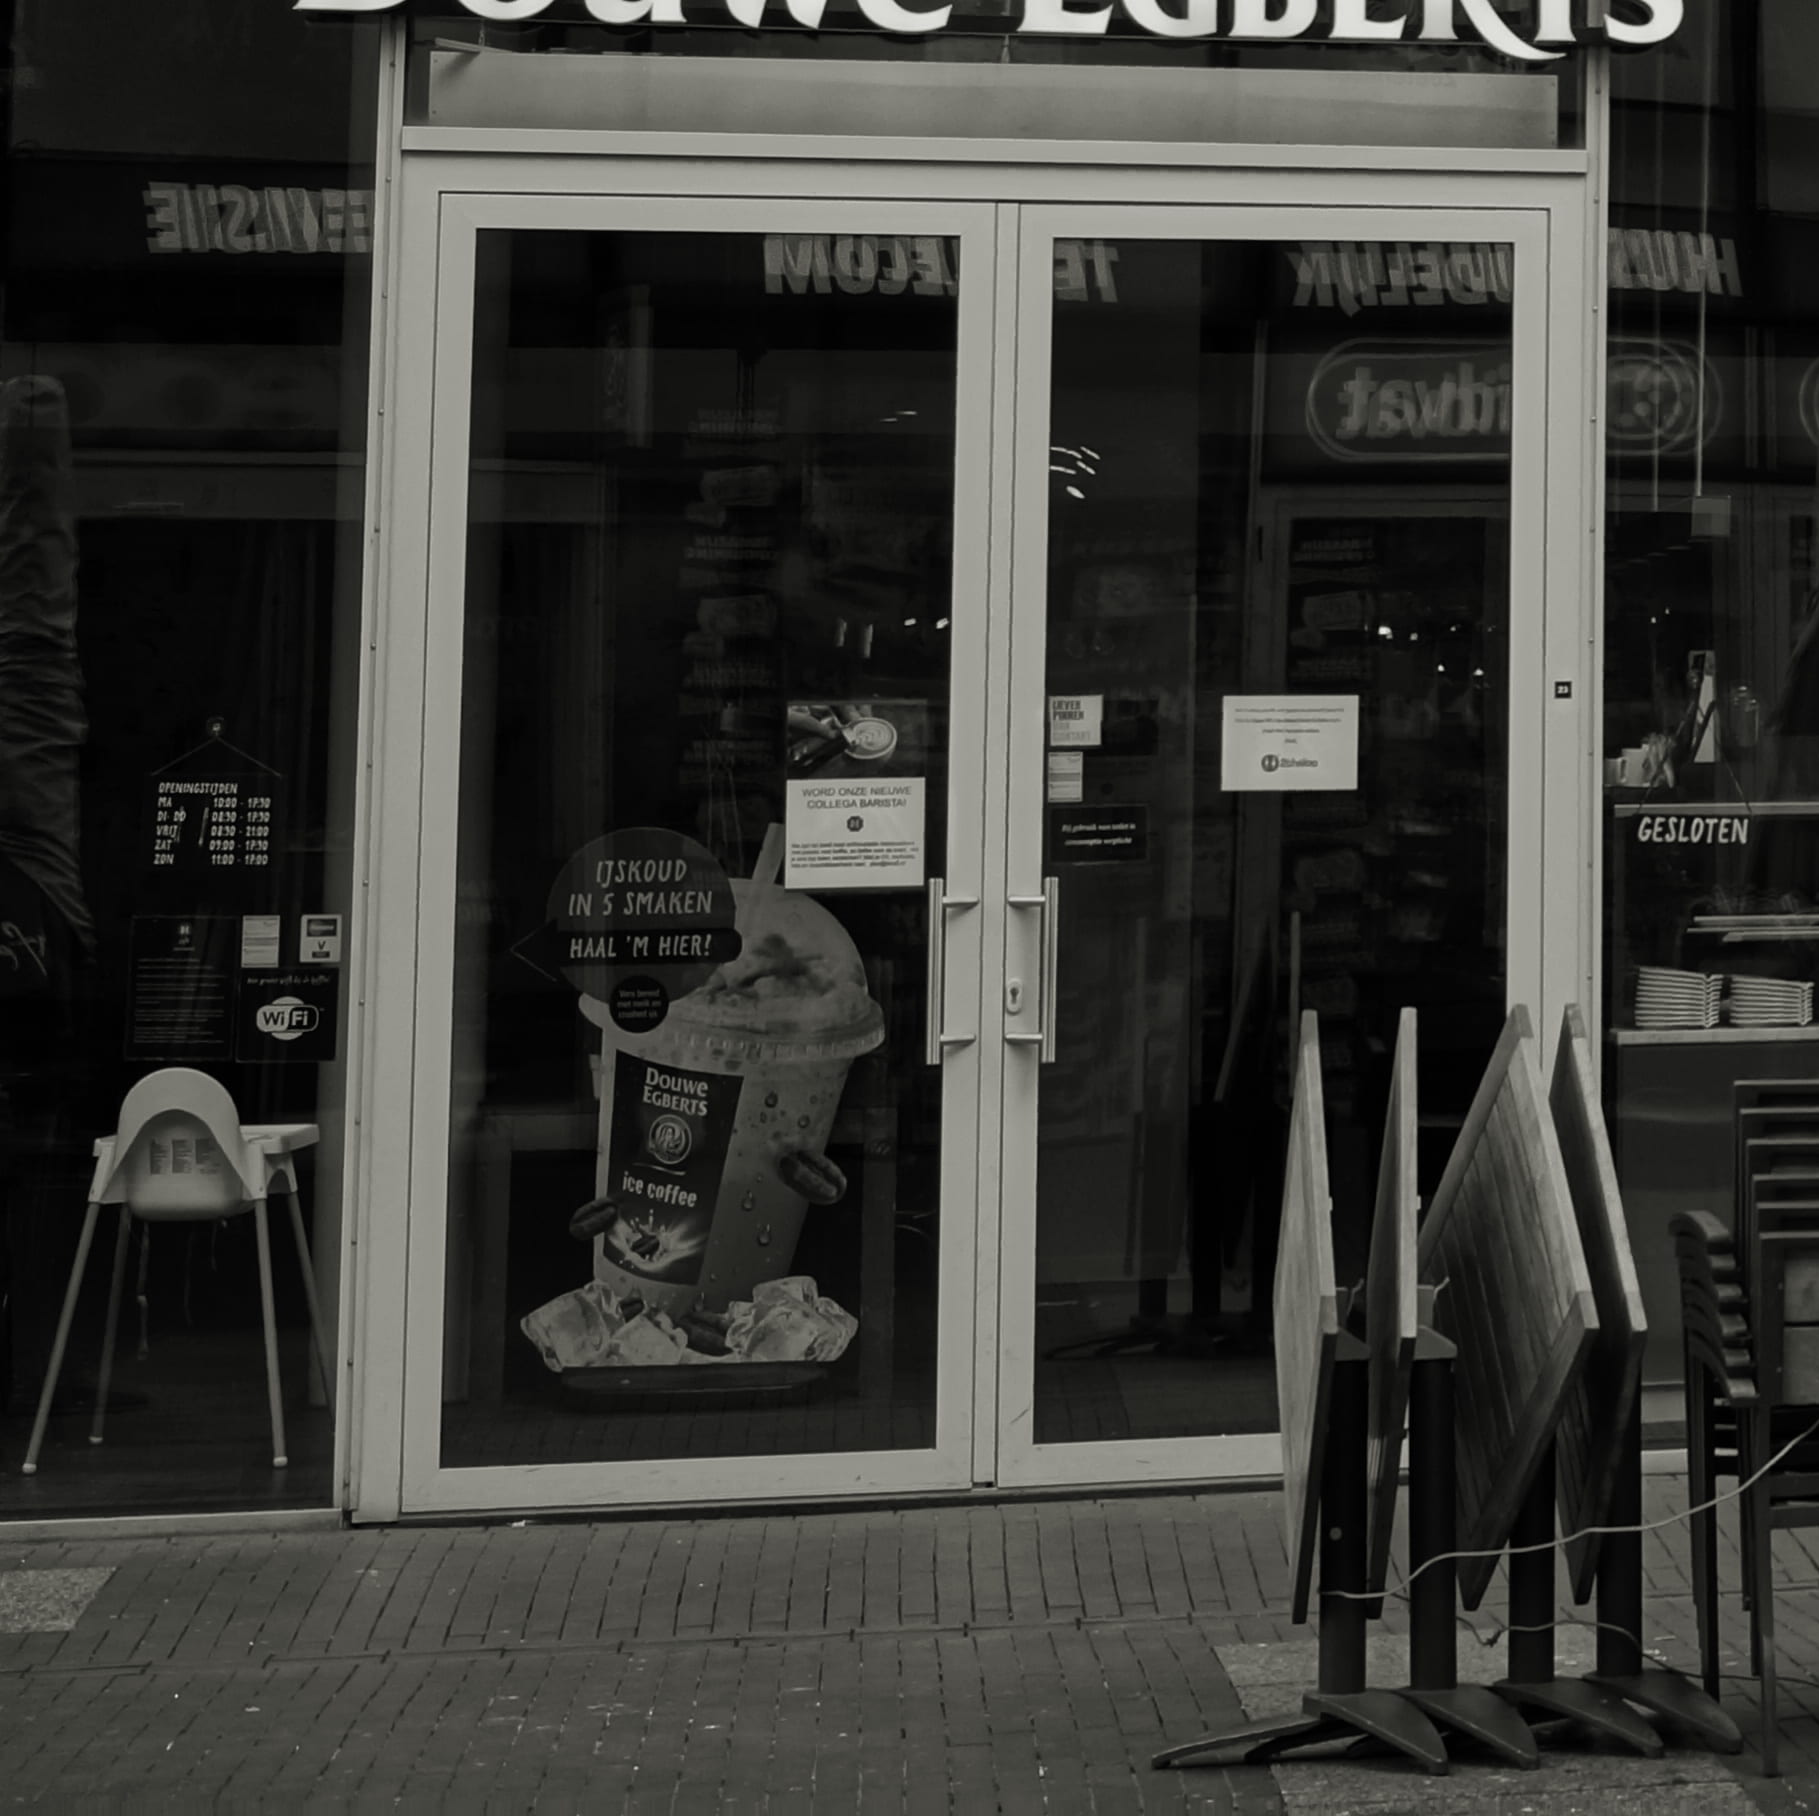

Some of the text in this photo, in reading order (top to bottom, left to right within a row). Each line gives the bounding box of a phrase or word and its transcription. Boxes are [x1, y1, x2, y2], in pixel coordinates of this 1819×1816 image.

[158, 782, 238, 796] OPENINGSTIJDEN
[802, 785, 912, 798] WORD ONZE NIEUWE
[157, 796, 173, 808] MA
[213, 796, 238, 809] 10:00
[807, 798, 857, 809] COLLEGA
[156, 824, 179, 838] VRIJ
[1637, 815, 1749, 845] GESLOTEN
[154, 839, 173, 851] ZAT
[153, 853, 175, 865] ZON
[211, 853, 236, 866] 11:00
[595, 858, 688, 889] IJSKOUD
[567, 890, 713, 917] IN 5 SMAKEN
[569, 936, 617, 959] HAAL
[657, 933, 713, 957] HIER!
[642, 1085, 709, 1117] EGBERTS
[622, 1170, 698, 1208] ice coffee
